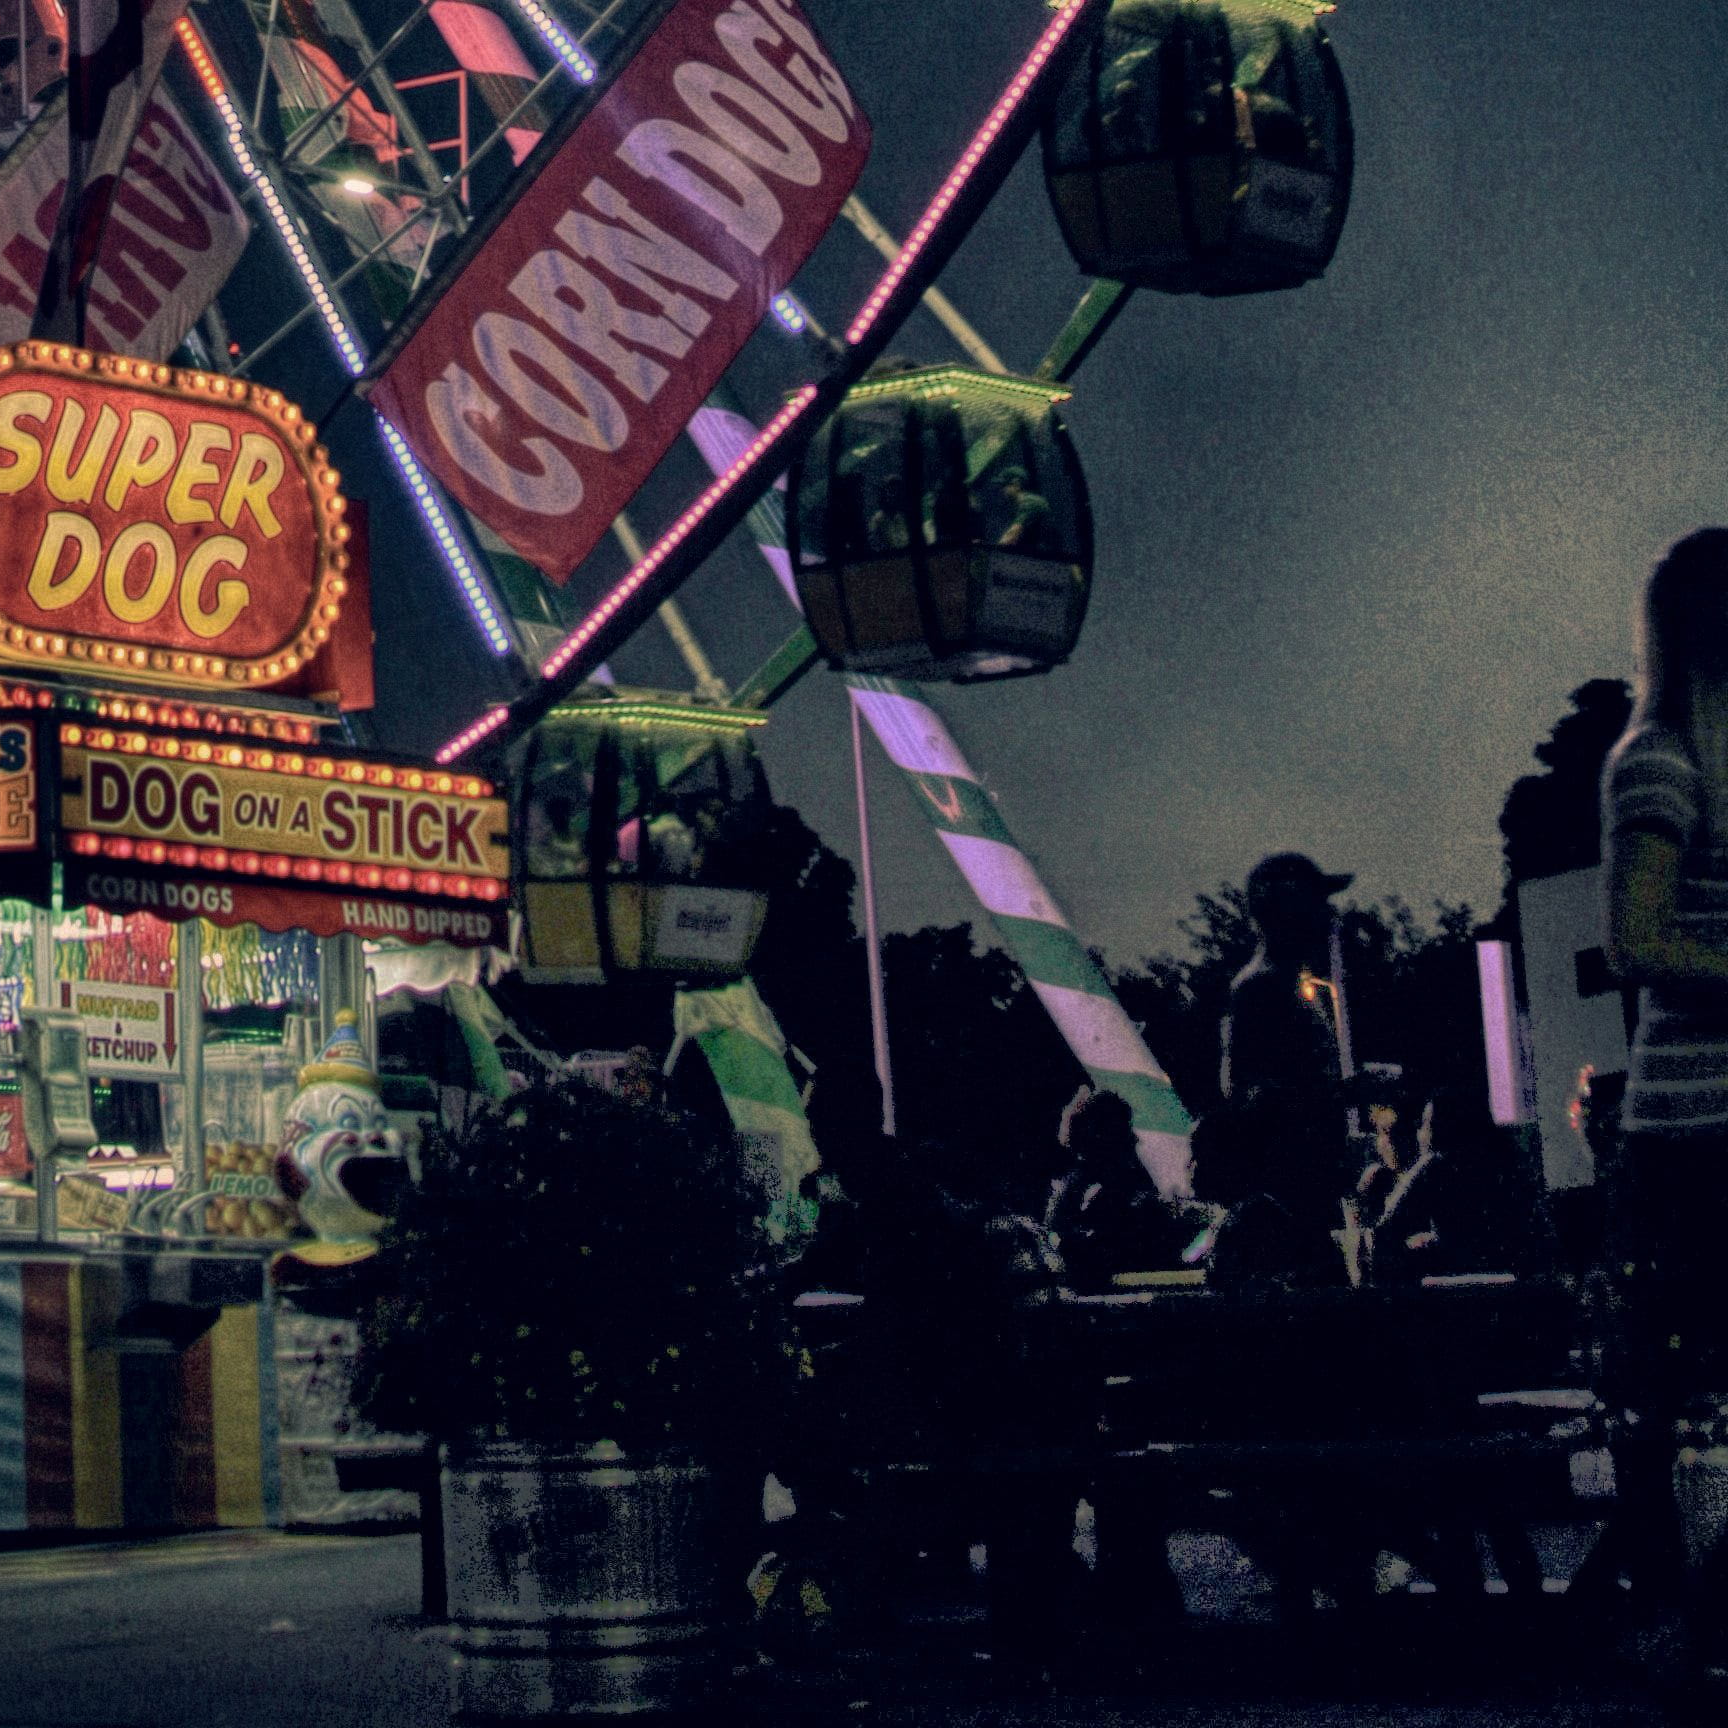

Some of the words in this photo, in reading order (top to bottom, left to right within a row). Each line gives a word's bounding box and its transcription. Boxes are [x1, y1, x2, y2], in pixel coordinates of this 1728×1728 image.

[424, 174, 740, 518] CORN
[27, 511, 250, 639] DOG
[89, 759, 222, 837] DOG
[233, 793, 281, 825] ON
[289, 806, 310, 832] A
[321, 789, 485, 867] STICK
[87, 874, 160, 904] CORN
[163, 886, 234, 913] DOGS
[342, 901, 411, 930] HAND
[415, 910, 491, 938] DIPPED
[77, 994, 159, 1021] MUSTARD
